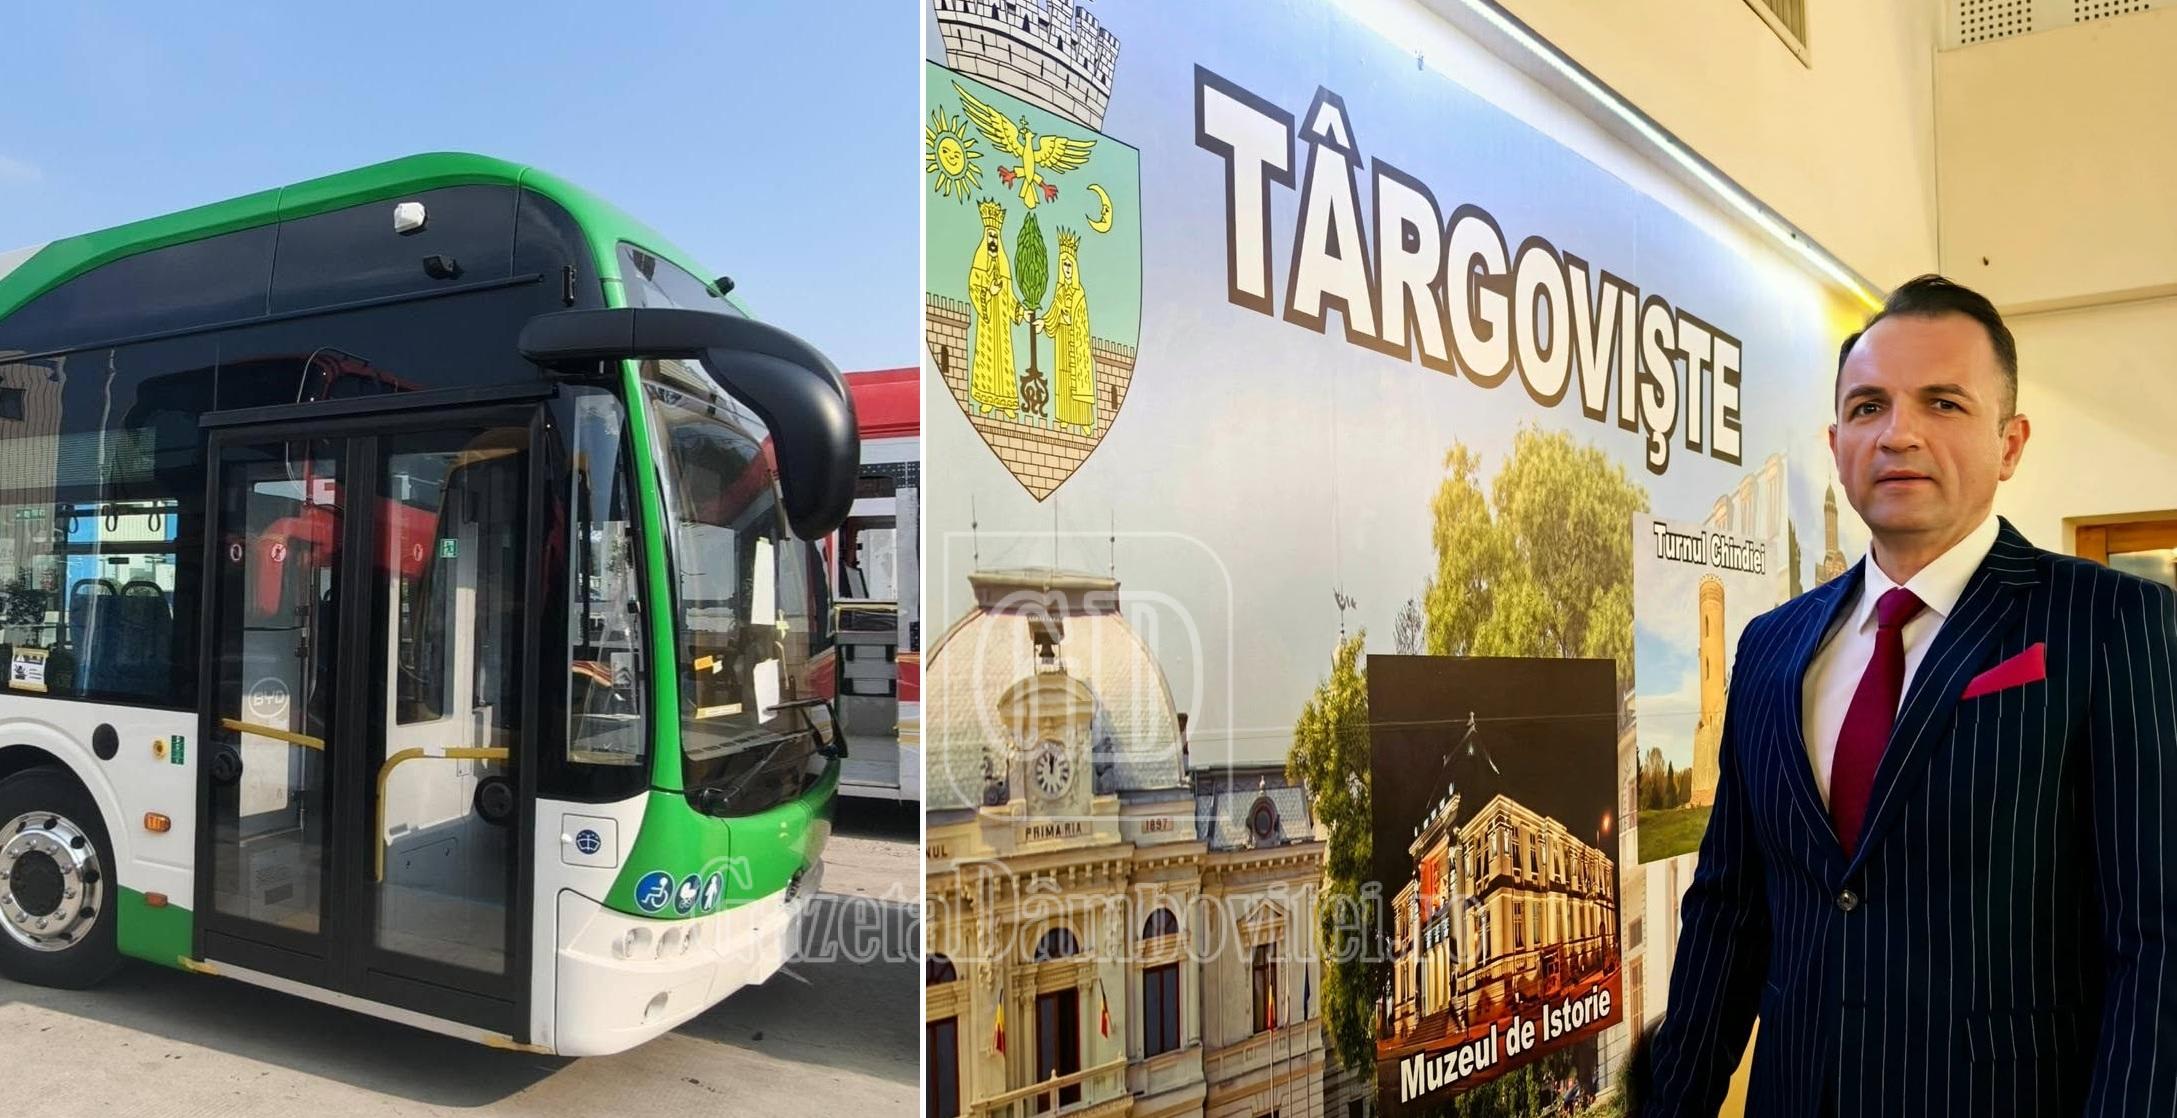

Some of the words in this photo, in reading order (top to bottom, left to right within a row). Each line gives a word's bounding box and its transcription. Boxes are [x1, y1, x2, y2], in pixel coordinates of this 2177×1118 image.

[1653, 521, 1707, 565] Turnul
[1711, 533, 1765, 575] Chindiei
[253, 690, 285, 706] BYD
[1145, 818, 1168, 831] 1897
[1400, 1024, 1499, 1104] Muzeul
[1505, 1015, 1536, 1058] de
[1542, 985, 1611, 1042] Istorie
